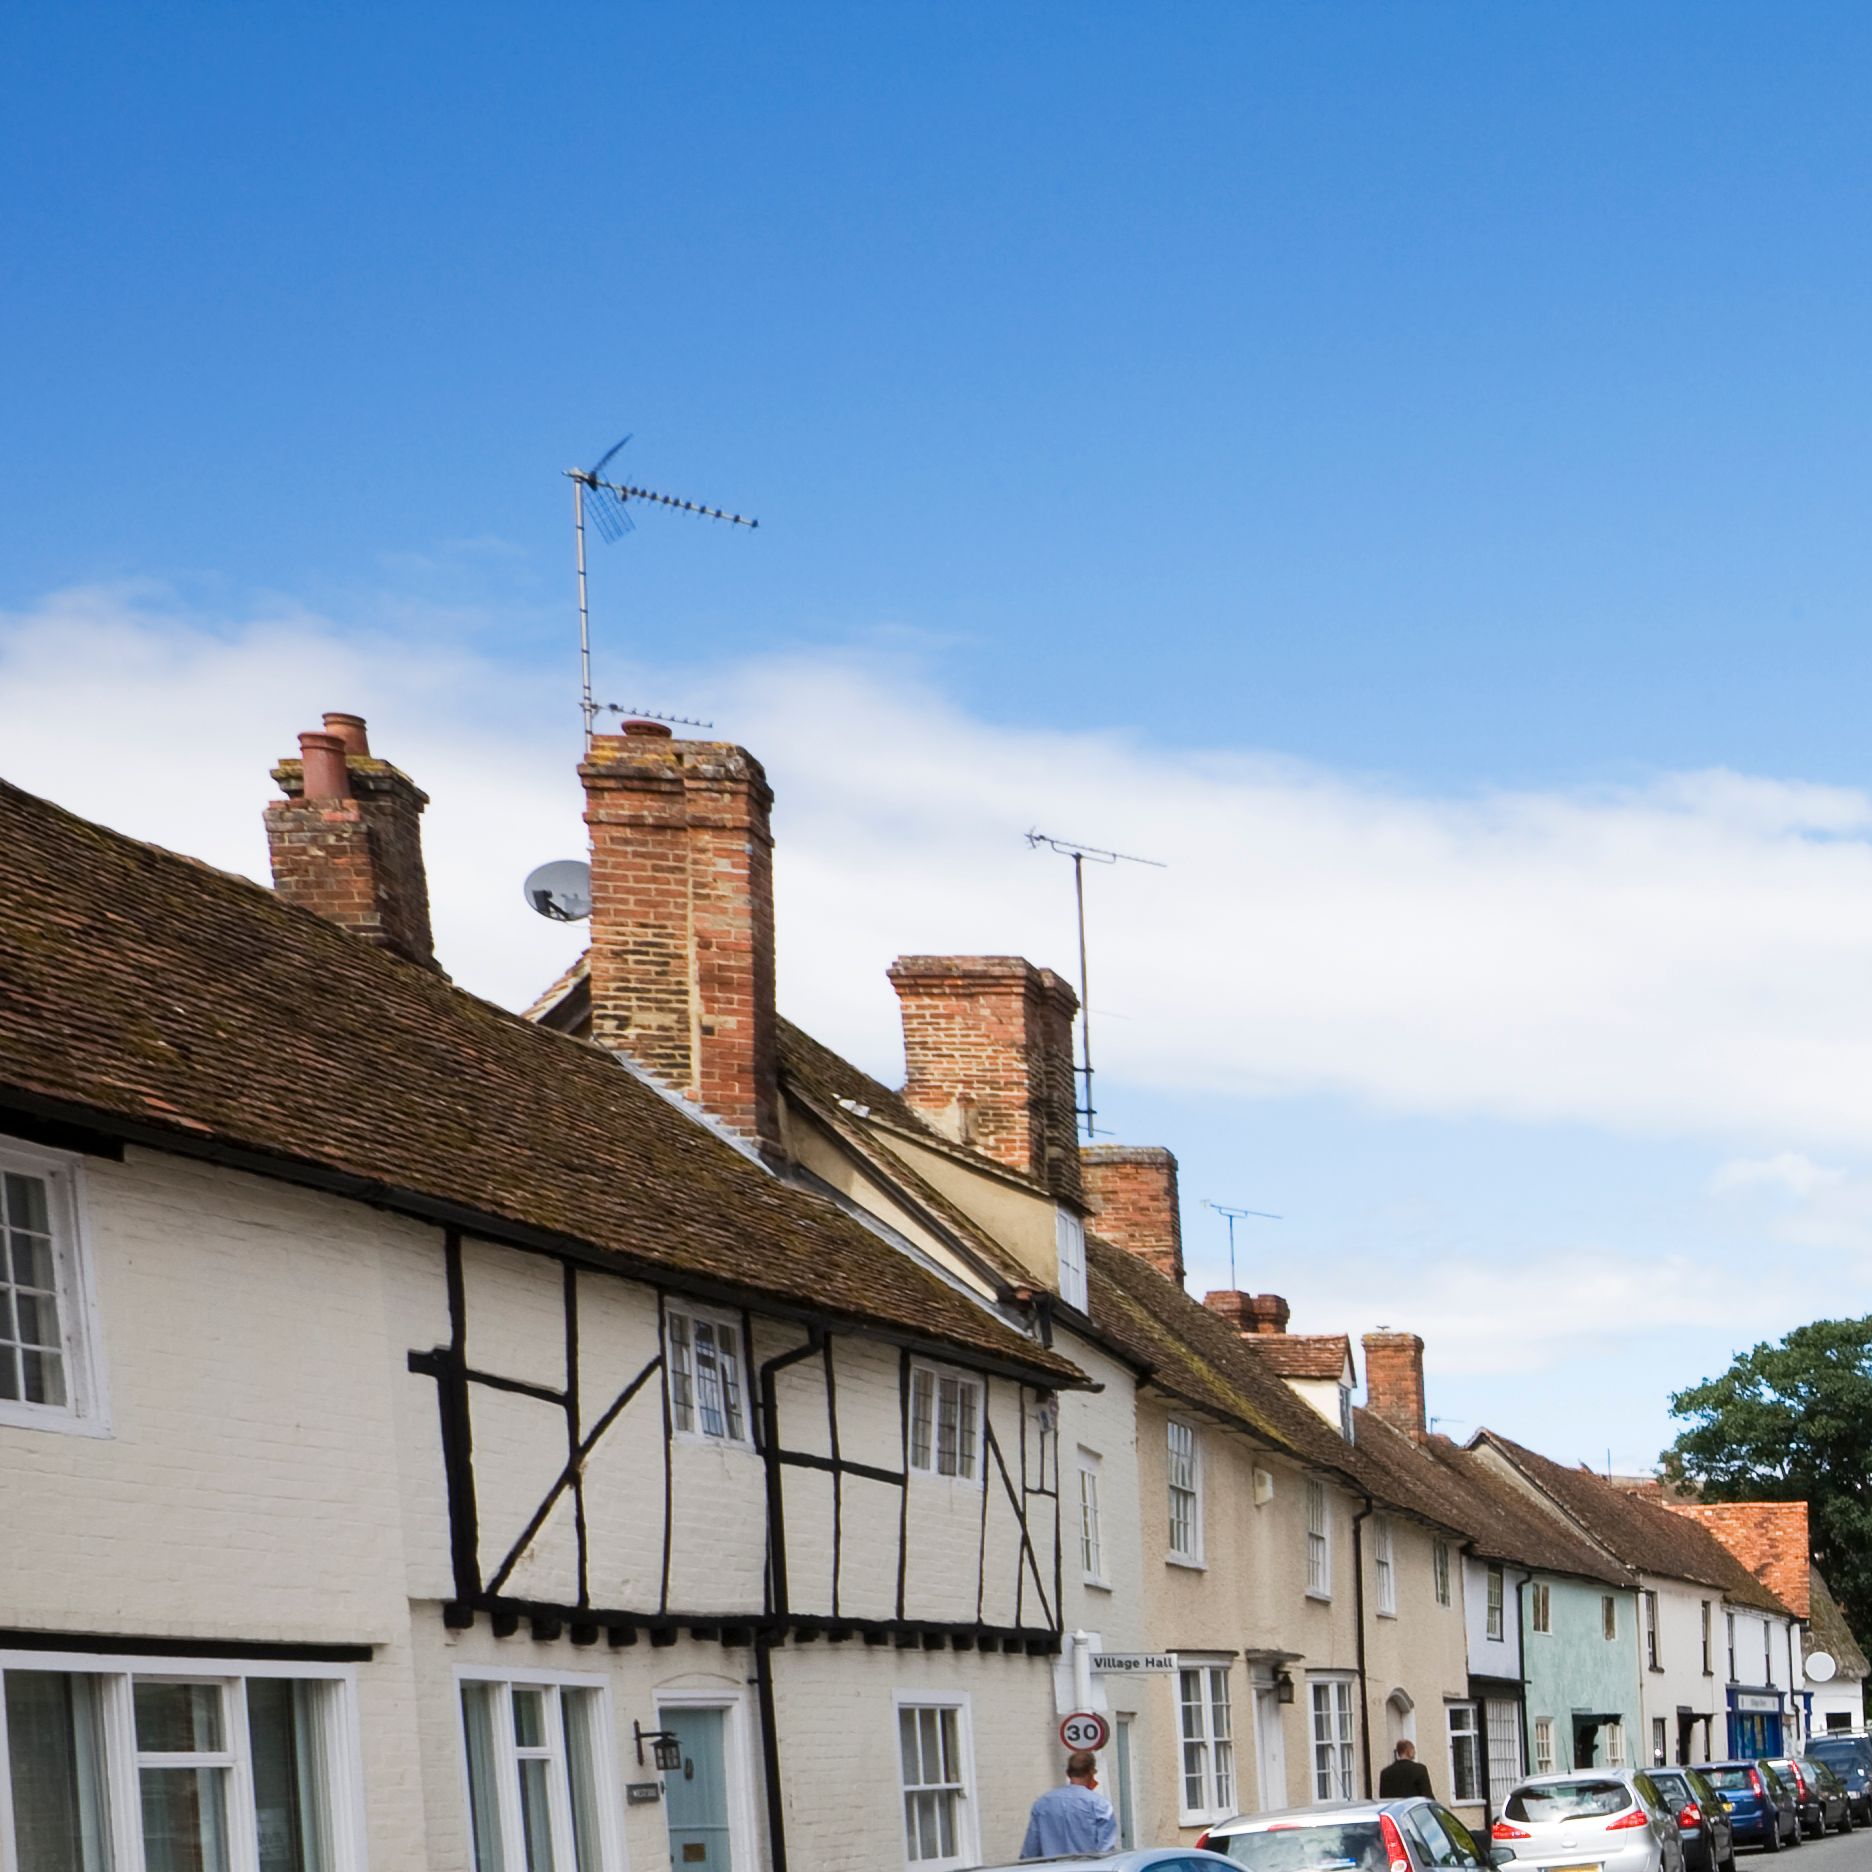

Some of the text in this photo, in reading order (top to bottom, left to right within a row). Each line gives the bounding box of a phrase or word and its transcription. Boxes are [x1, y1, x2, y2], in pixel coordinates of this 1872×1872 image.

[1093, 1657, 1173, 1670] Village Hall
[1066, 1724, 1099, 1741] 30
